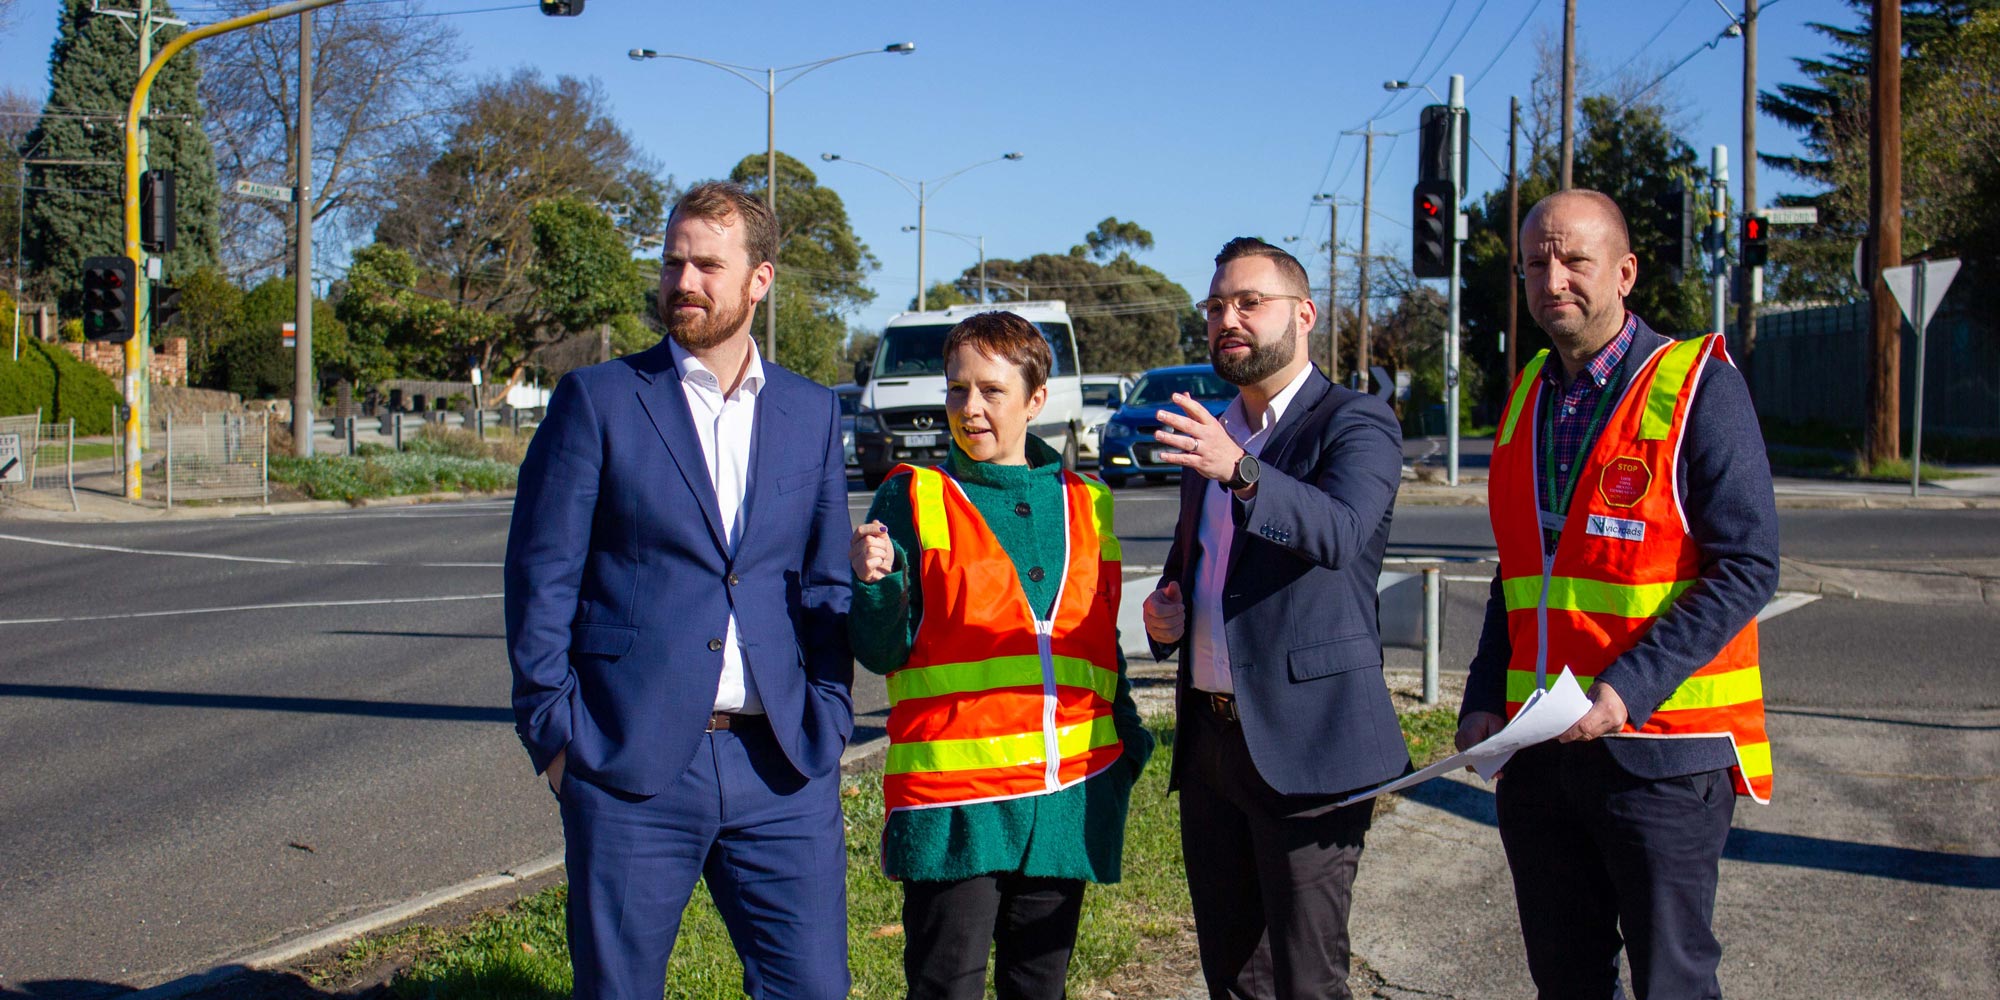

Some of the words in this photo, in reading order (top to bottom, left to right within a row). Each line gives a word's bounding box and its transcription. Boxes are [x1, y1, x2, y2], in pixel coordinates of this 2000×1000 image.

[0, 437, 14, 446] EEP
[0, 447, 14, 456] EFT
[1617, 463, 1638, 472] STOP
